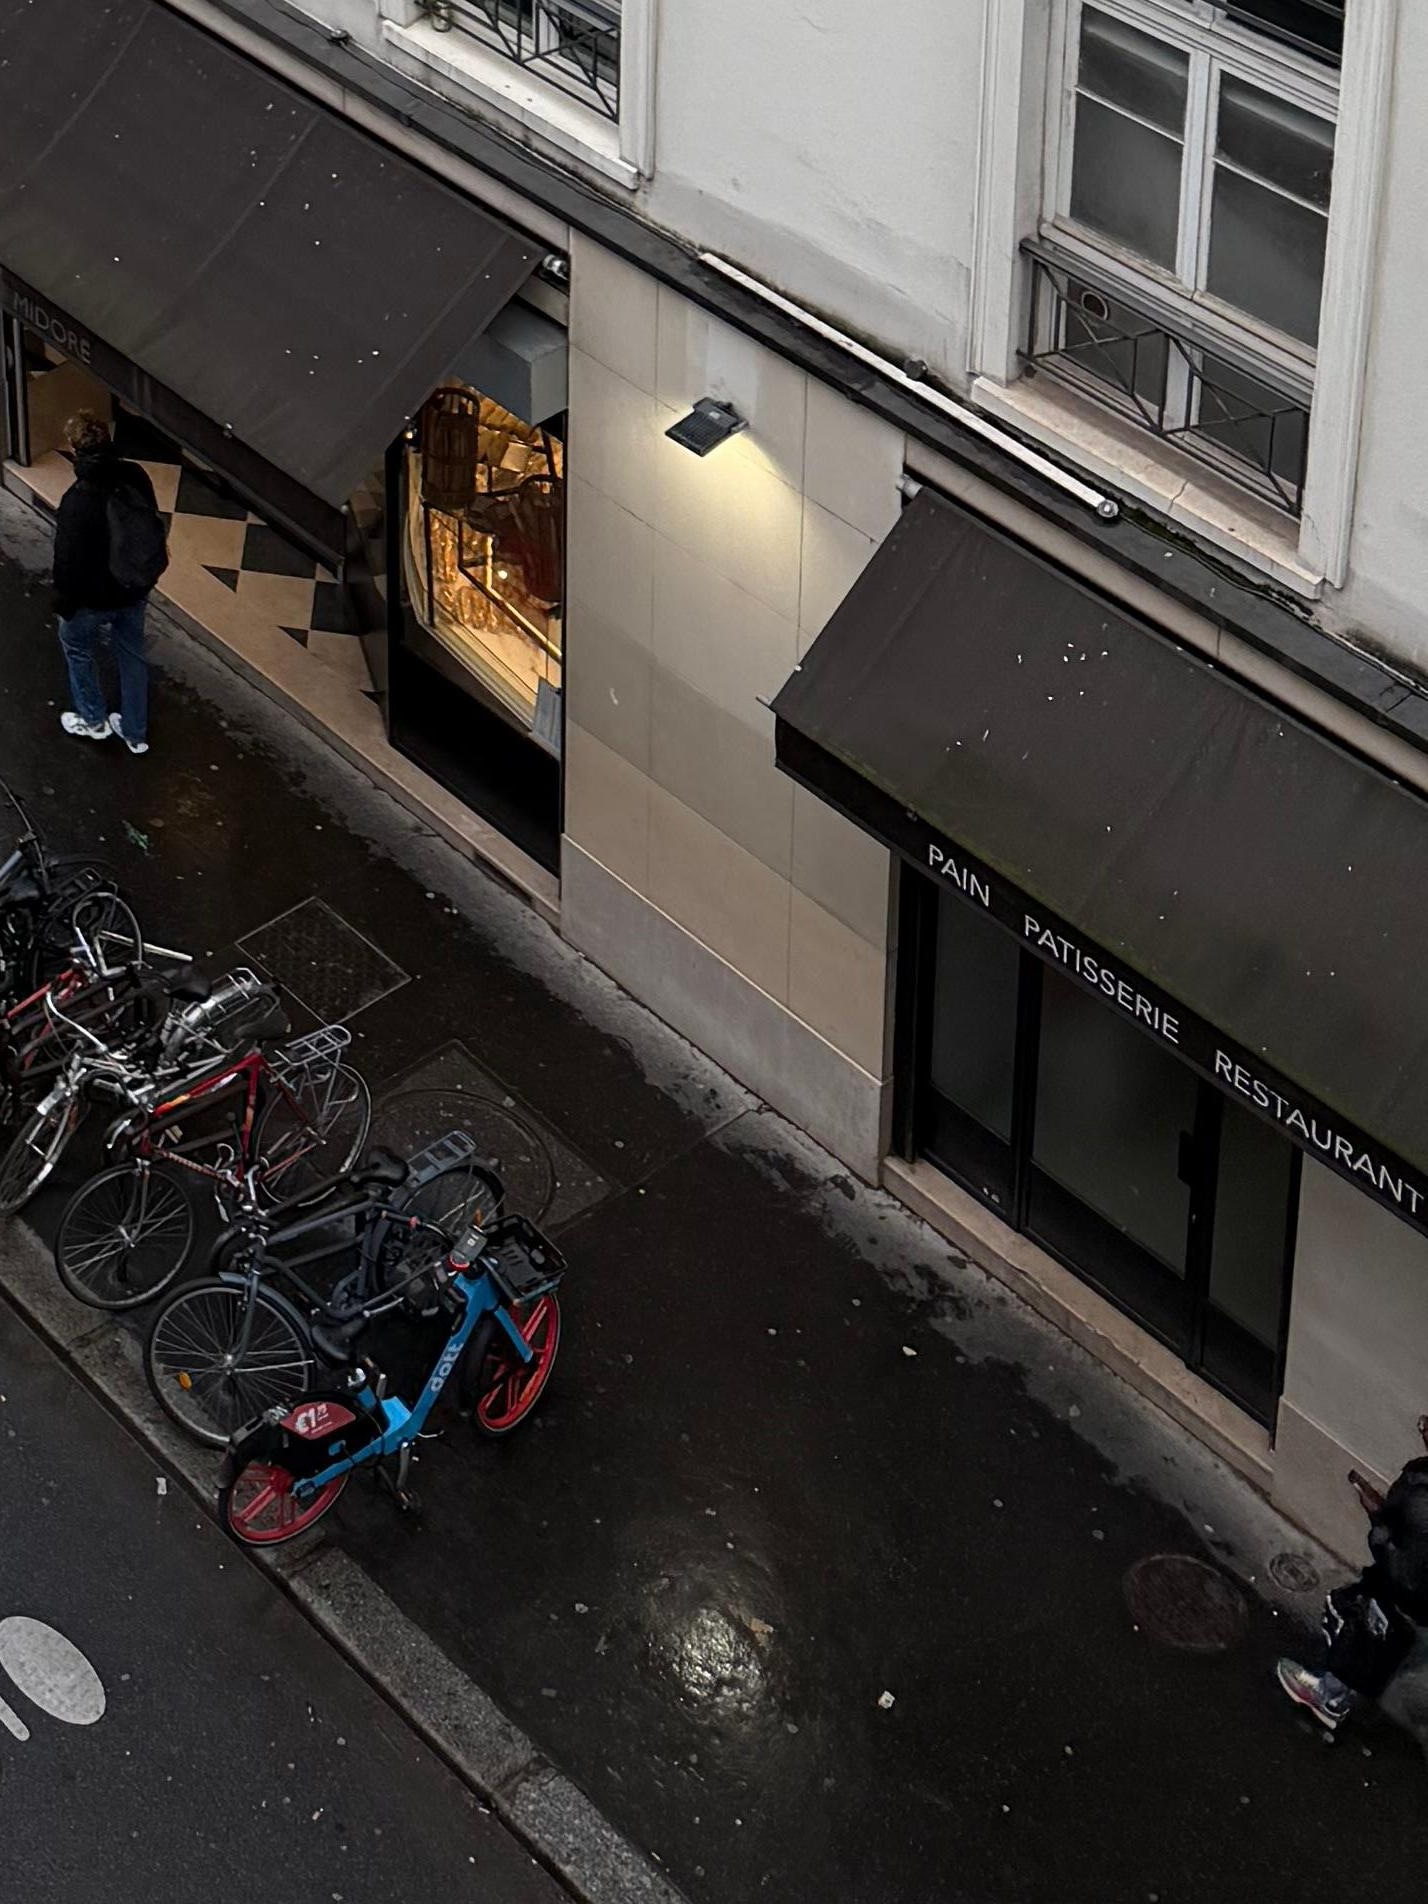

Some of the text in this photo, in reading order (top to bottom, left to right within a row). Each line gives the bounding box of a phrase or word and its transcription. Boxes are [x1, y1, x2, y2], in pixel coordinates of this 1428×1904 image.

[927, 843, 1425, 1214] PAIN PATISSERIE RESTAURANT
[430, 1342, 464, 1392] dott
